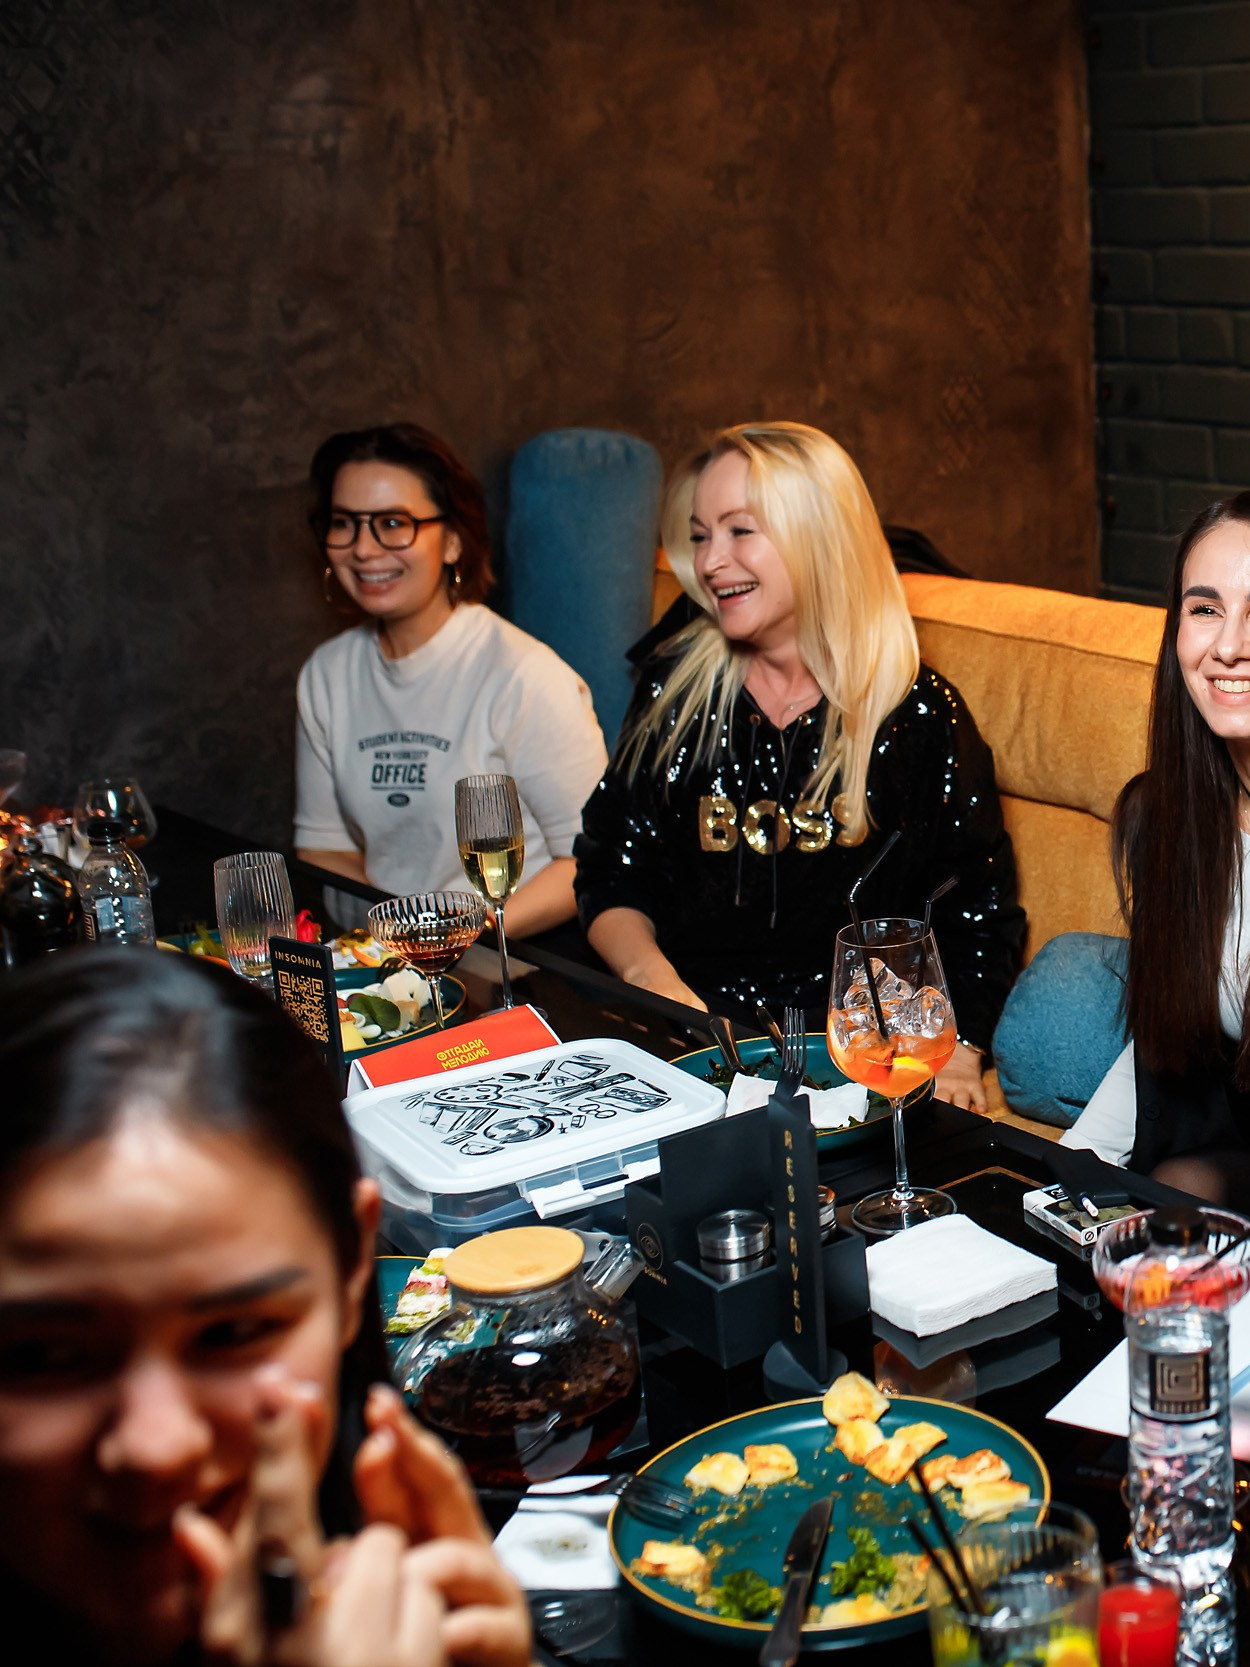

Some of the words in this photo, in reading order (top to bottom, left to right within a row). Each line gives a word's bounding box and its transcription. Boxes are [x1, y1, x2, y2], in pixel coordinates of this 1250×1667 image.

[358, 732, 399, 752] STUDENT
[400, 731, 450, 753] ACTIVITIES
[374, 751, 391, 760] NEW
[371, 763, 427, 784] OFFICE
[274, 950, 322, 969] INSOMNIA
[436, 1038, 485, 1061] ОТГАДАЙ
[441, 1047, 490, 1071] МЕЛОДИЮ
[784, 1129, 802, 1335] RESERVED
